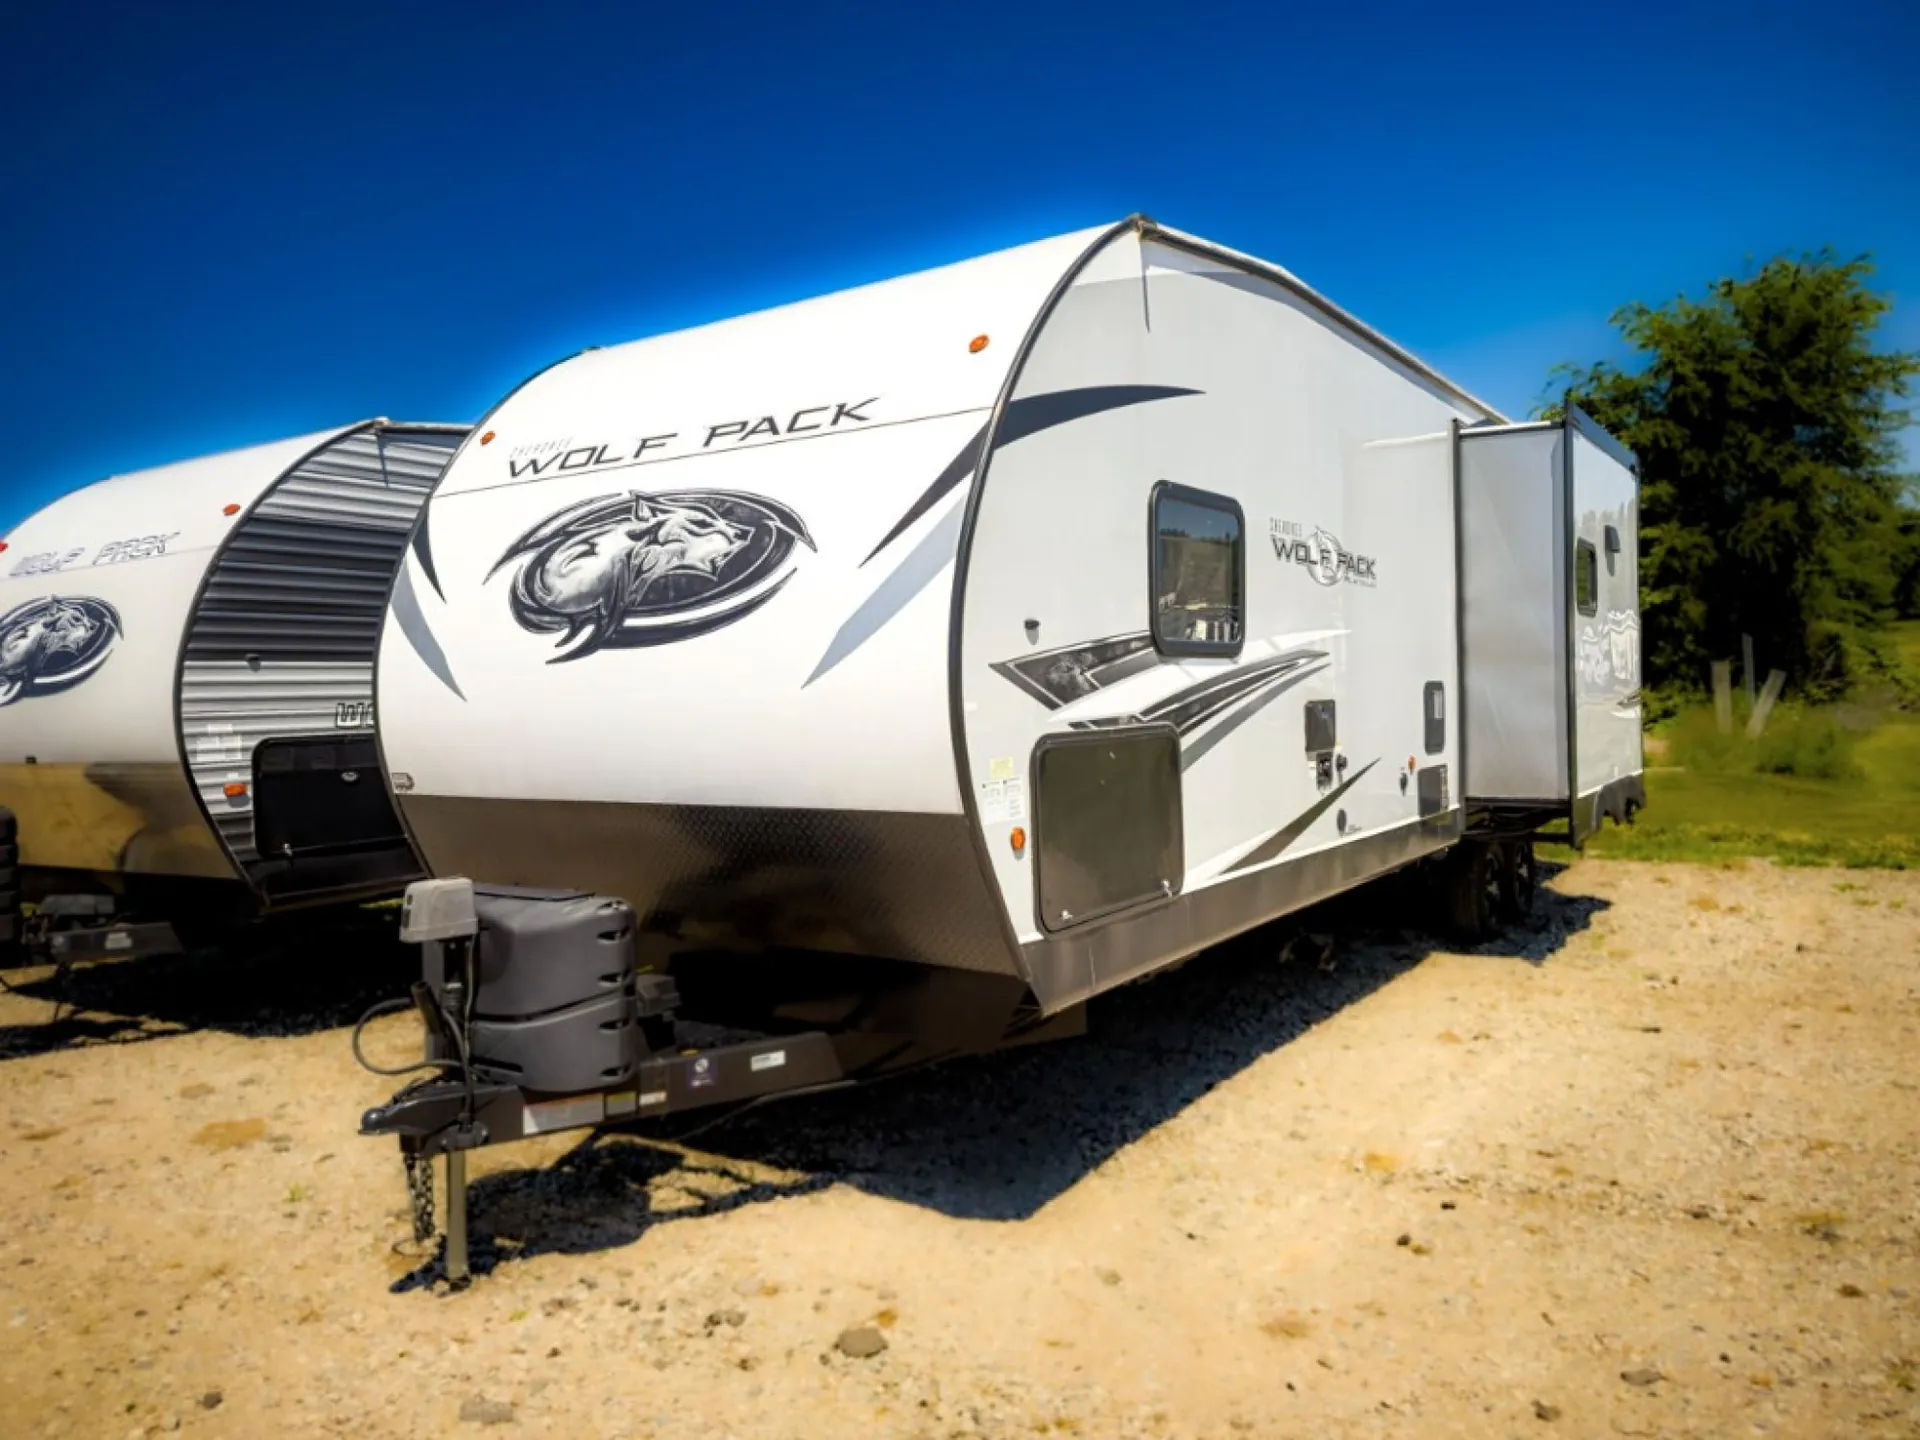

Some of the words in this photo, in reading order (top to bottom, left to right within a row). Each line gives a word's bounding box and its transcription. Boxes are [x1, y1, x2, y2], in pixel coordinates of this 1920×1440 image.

[508, 432, 679, 478] WOLF
[702, 396, 881, 448] PACK
[1269, 533, 1332, 566] WOLF
[1337, 551, 1377, 580] PACK
